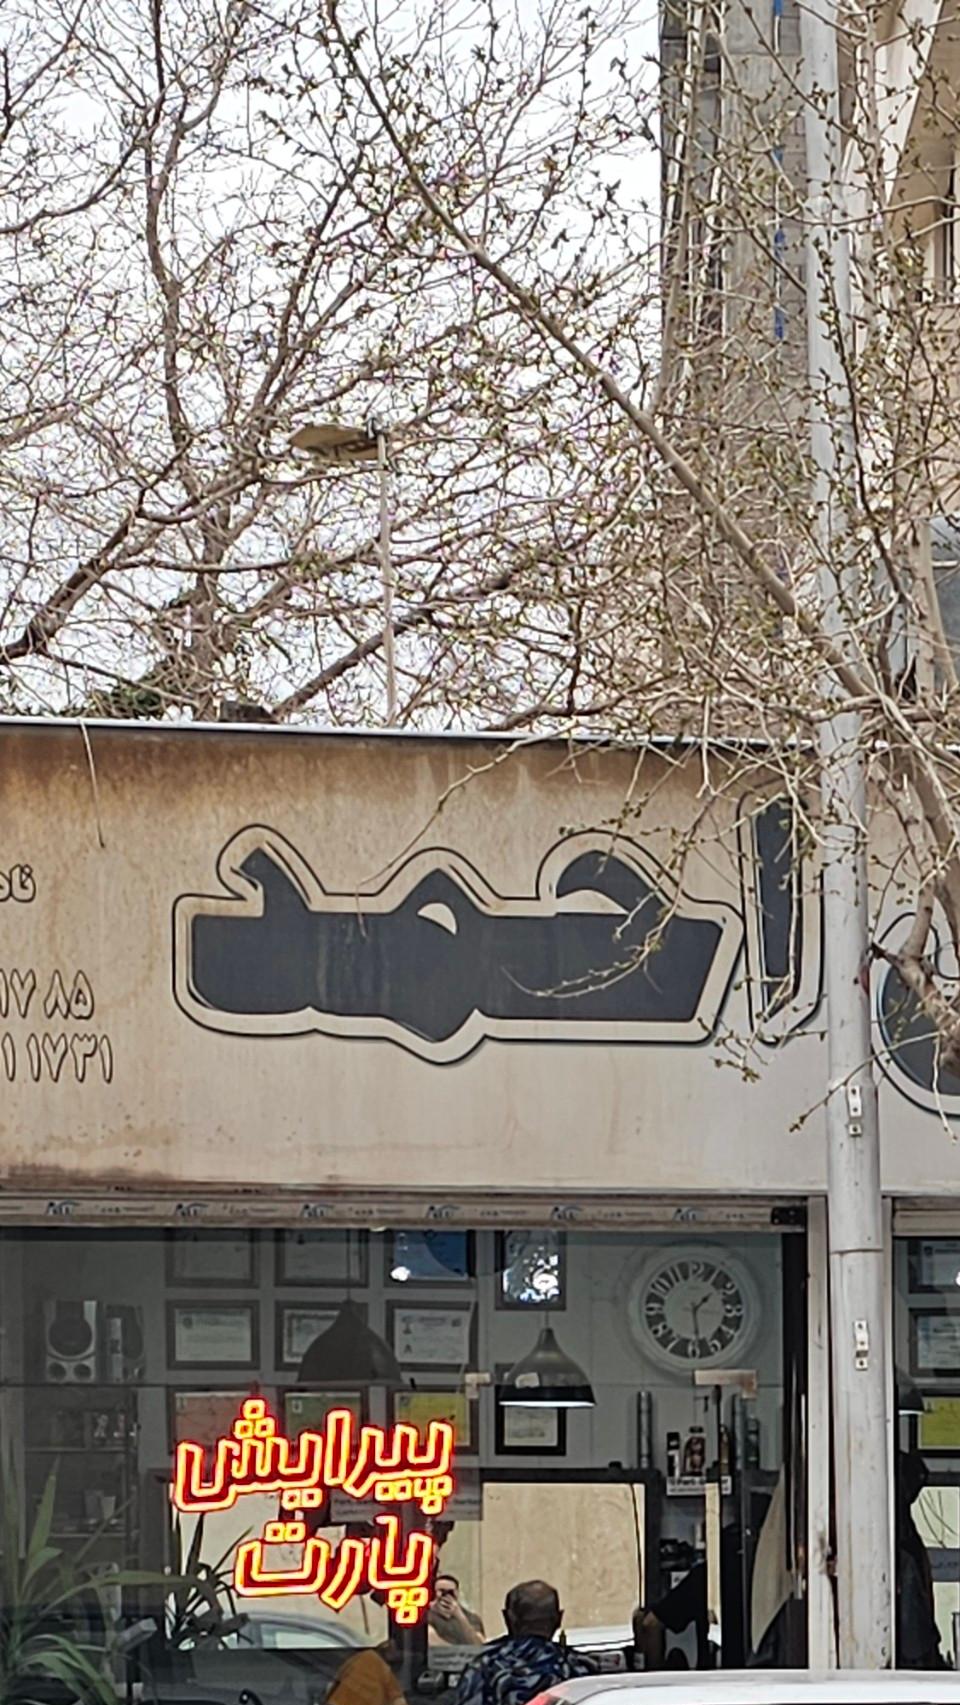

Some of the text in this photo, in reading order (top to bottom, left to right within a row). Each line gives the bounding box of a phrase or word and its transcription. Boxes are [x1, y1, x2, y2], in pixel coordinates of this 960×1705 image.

[172, 786, 824, 1067] احمد
[174, 1397, 454, 1514] پیرایش
[234, 1515, 434, 1625] پارت
